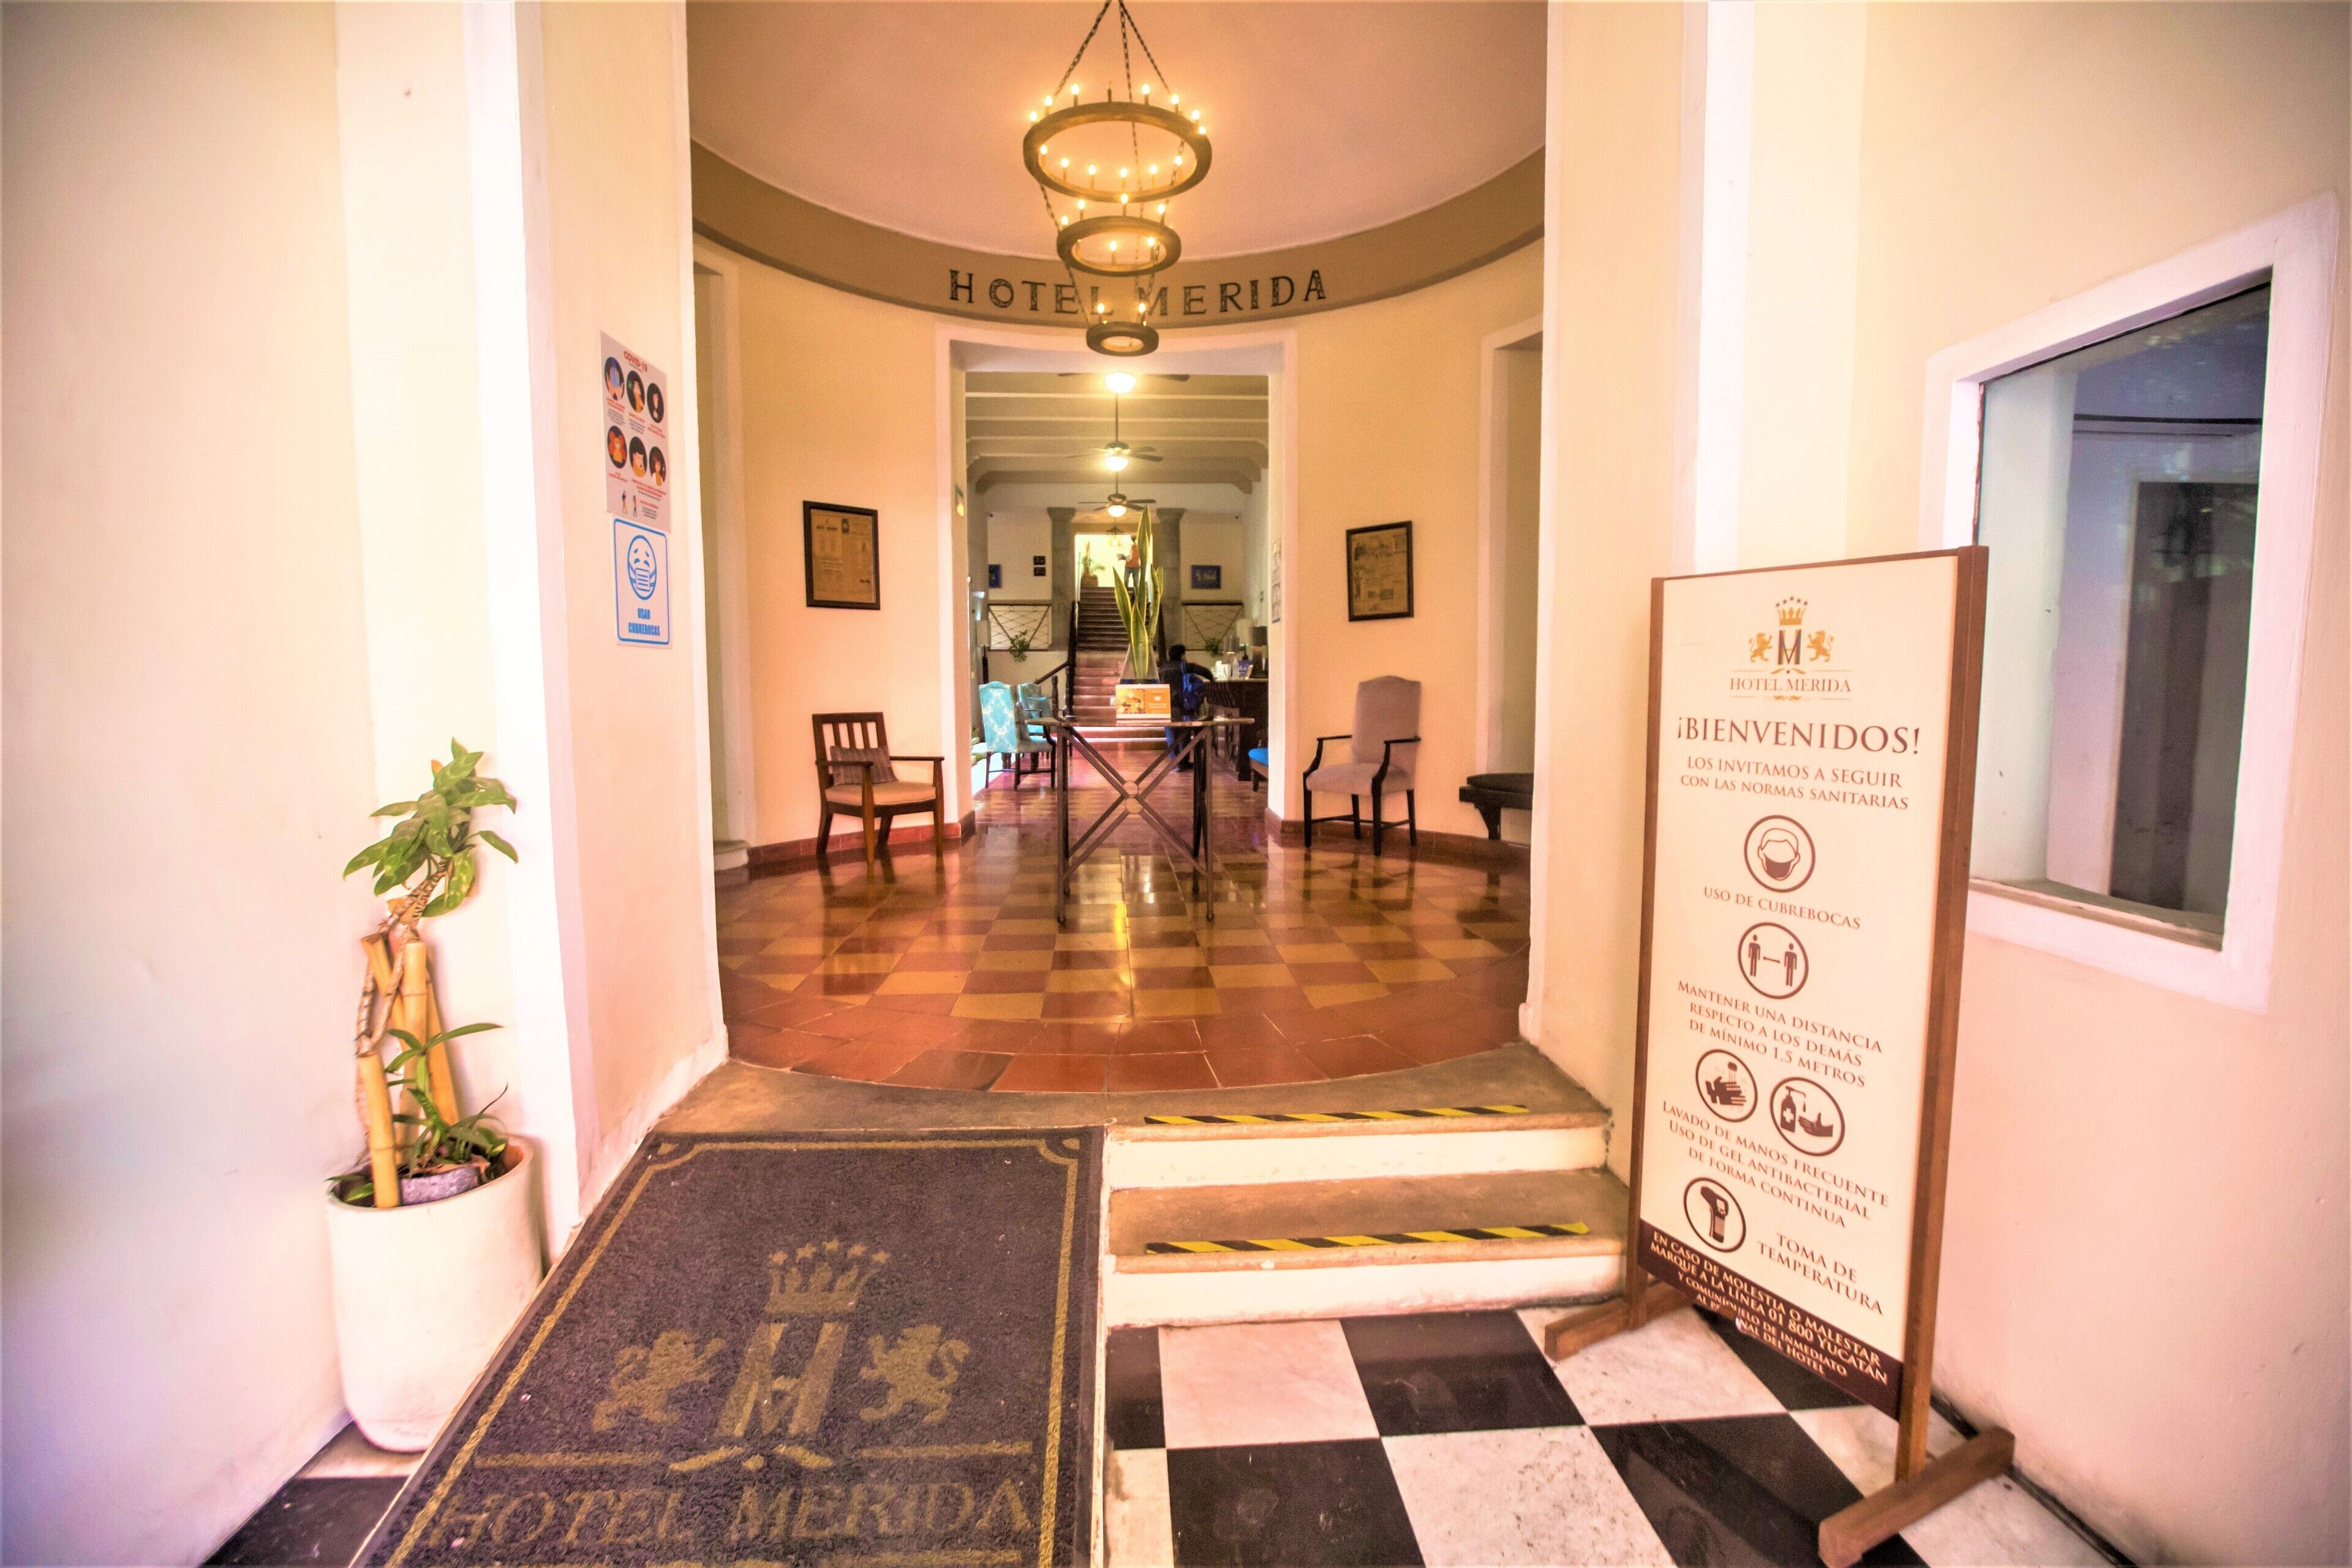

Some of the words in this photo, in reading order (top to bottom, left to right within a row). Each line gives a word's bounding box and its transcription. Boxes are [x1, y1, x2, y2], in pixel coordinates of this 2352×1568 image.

[949, 270, 1114, 316] HOTEL
[1138, 270, 1327, 316] MERIDA
[624, 350, 647, 372] COVID-19
[628, 622, 660, 636] CUBREBOCAS
[638, 608, 650, 619] USAR
[1730, 677, 1782, 692] HOTEL
[1787, 678, 1851, 692] MERIDA
[1677, 717, 1920, 755] ¡BIENVENIDOS!
[1681, 775, 1709, 788] CON
[1714, 778, 1736, 792] LAS
[1741, 782, 1804, 799] NORMAS
[1809, 789, 1909, 810] SANITARIAS
[1687, 756, 1713, 771] LOS
[1719, 760, 1809, 780] INVITAMOS
[1815, 768, 1825, 780] A
[1831, 769, 1902, 788] SEGUIR
[1704, 887, 1730, 902] USO
[1735, 894, 1754, 907] DE
[1758, 899, 1861, 929] CUBREBOCAS
[1678, 981, 1750, 1014] MANTENER
[1755, 1006, 1787, 1024] UNA
[1792, 1017, 1882, 1054] DISTANCIA
[1690, 1002, 1755, 1033] RESPECTO
[1758, 1026, 1768, 1037] A
[1773, 1030, 1800, 1047] LOS
[1806, 1040, 1862, 1067] DEMÁS
[1689, 1019, 1706, 1035] DE
[1709, 1027, 1767, 1055] MÍNIMO
[1773, 1047, 1793, 1065] 1.5
[1798, 1058, 1866, 1088] METROS
[1663, 1101, 1710, 1131] LAVADO
[1714, 1125, 1731, 1141] DE
[1736, 1136, 1788, 1166] MANOS
[1793, 1160, 1889, 1207] FRECUENTE
[1669, 1120, 1695, 1141] USO
[1699, 1135, 1716, 1152] DE
[1719, 1145, 1743, 1165] GEL
[1747, 1158, 1871, 1220] ANTIBACTERIAL
[1688, 1147, 1705, 1163] DE
[1709, 1156, 1756, 1188] FORMA
[1760, 1182, 1846, 1229] CONTINUA
[1757, 1240, 1883, 1316] TEMPERATURA
[1776, 1232, 1828, 1270] TOMA
[1833, 1259, 1857, 1284] DE
[1651, 1242, 1697, 1276] MARQUE
[1699, 1270, 1708, 1283] A
[1711, 1276, 1725, 1293] LA
[1768, 1306, 1783, 1327] 01
[1789, 1318, 1814, 1343] 800
[1654, 1231, 1668, 1247] EN
[1671, 1242, 1700, 1265] CASO
[1704, 1259, 1720, 1278] DE
[1723, 1270, 1786, 1315] MOLESTIA
[1790, 1308, 1801, 1321] O
[1805, 1316, 1881, 1367] MALESTAR
[1678, 1270, 1684, 1281] Y
[1763, 1321, 1777, 1337] DE
[1780, 1331, 1847, 1376] INMEDIATO
[1763, 1332, 1783, 1351] DEL
[1786, 1344, 1825, 1376] HOTEL
[426, 1488, 686, 1547] HOTEL
[732, 1477, 1036, 1540] MERIDA
